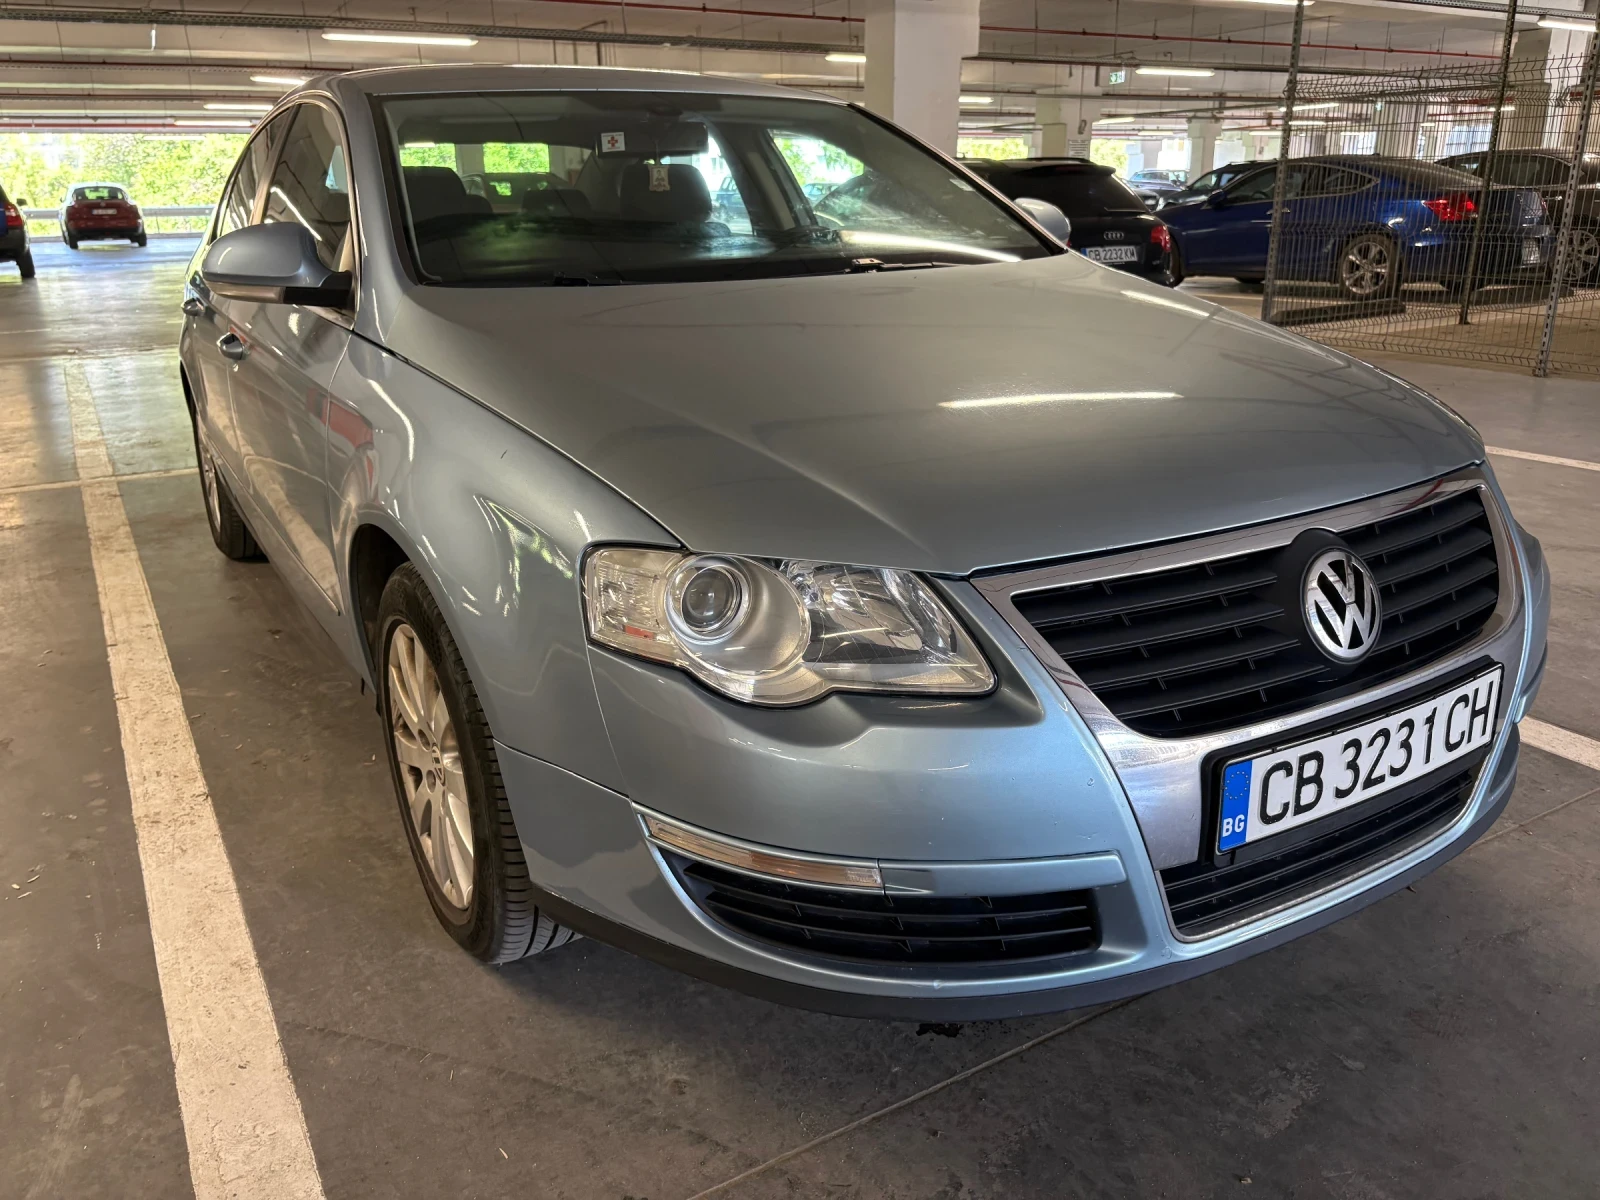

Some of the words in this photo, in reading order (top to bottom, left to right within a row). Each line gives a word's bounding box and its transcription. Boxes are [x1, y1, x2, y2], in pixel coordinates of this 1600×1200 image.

[1102, 248, 1124, 261] 2232
[1259, 750, 1324, 825] CB
[1334, 707, 1438, 799] 3231
[1444, 680, 1494, 753] CH
[1221, 813, 1246, 838] BG
